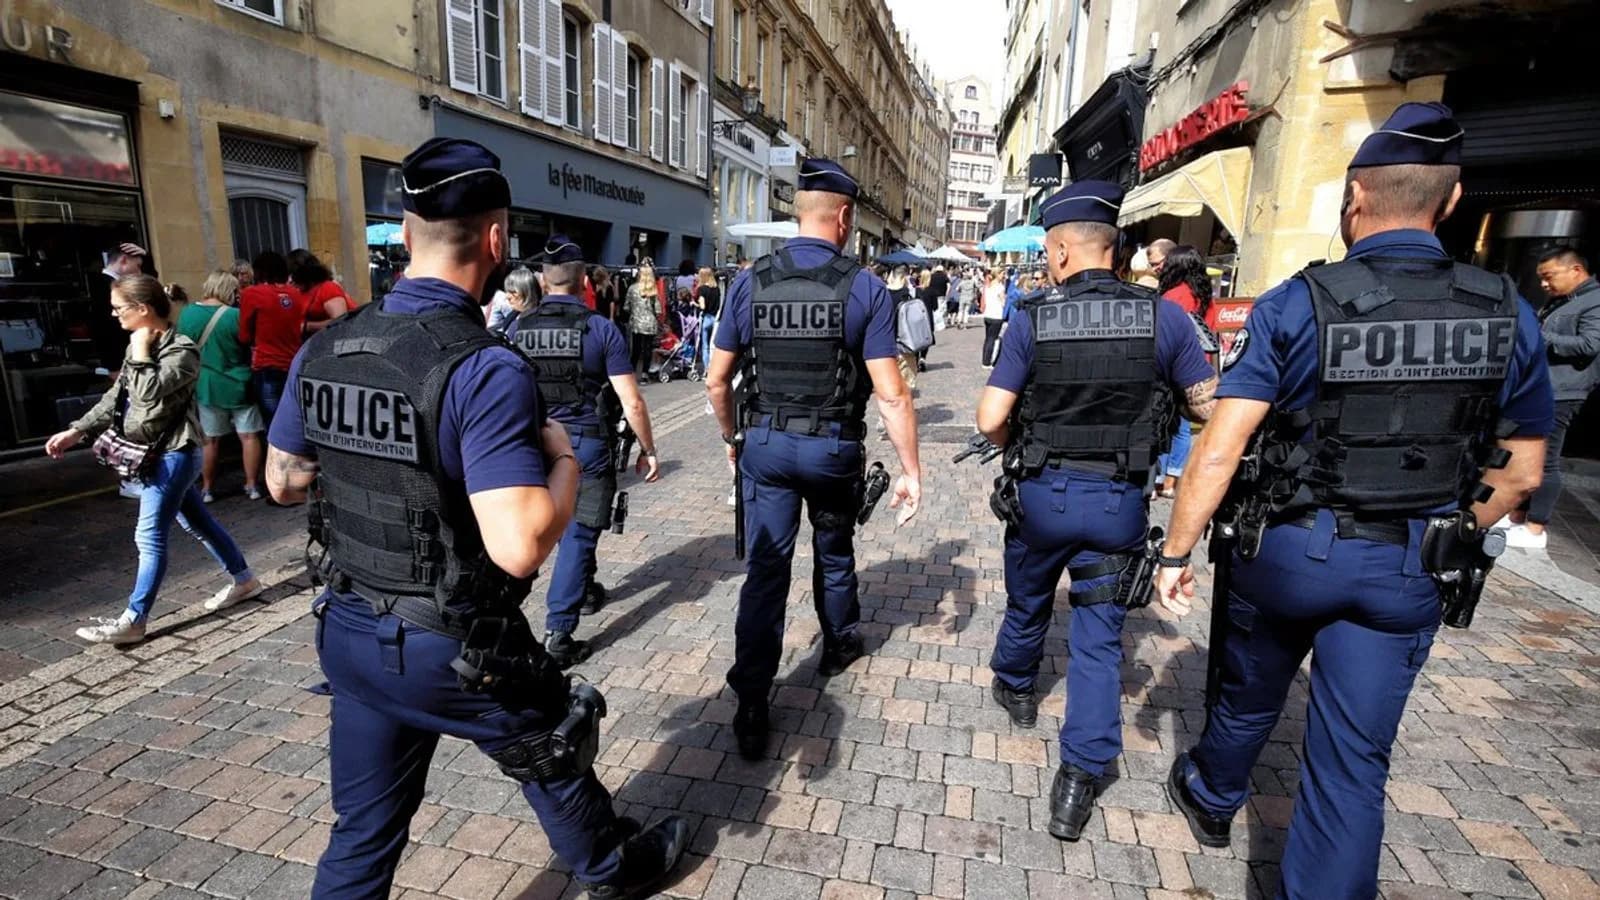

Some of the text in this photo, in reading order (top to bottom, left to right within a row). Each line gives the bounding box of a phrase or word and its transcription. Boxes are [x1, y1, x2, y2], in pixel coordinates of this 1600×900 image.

[548, 162, 646, 206] la fée maraboutée
[753, 304, 841, 329] POLICE
[1038, 301, 1152, 331] POLICE
[515, 330, 579, 350] POLICE
[1038, 327, 1152, 338] SECTION D'INTERVENTION
[1329, 320, 1512, 368] POLICE
[1328, 366, 1505, 379] SECTION D'INTERVENTION
[301, 380, 414, 444] POLICE
[333, 434, 413, 457] D'INTERVENTION
